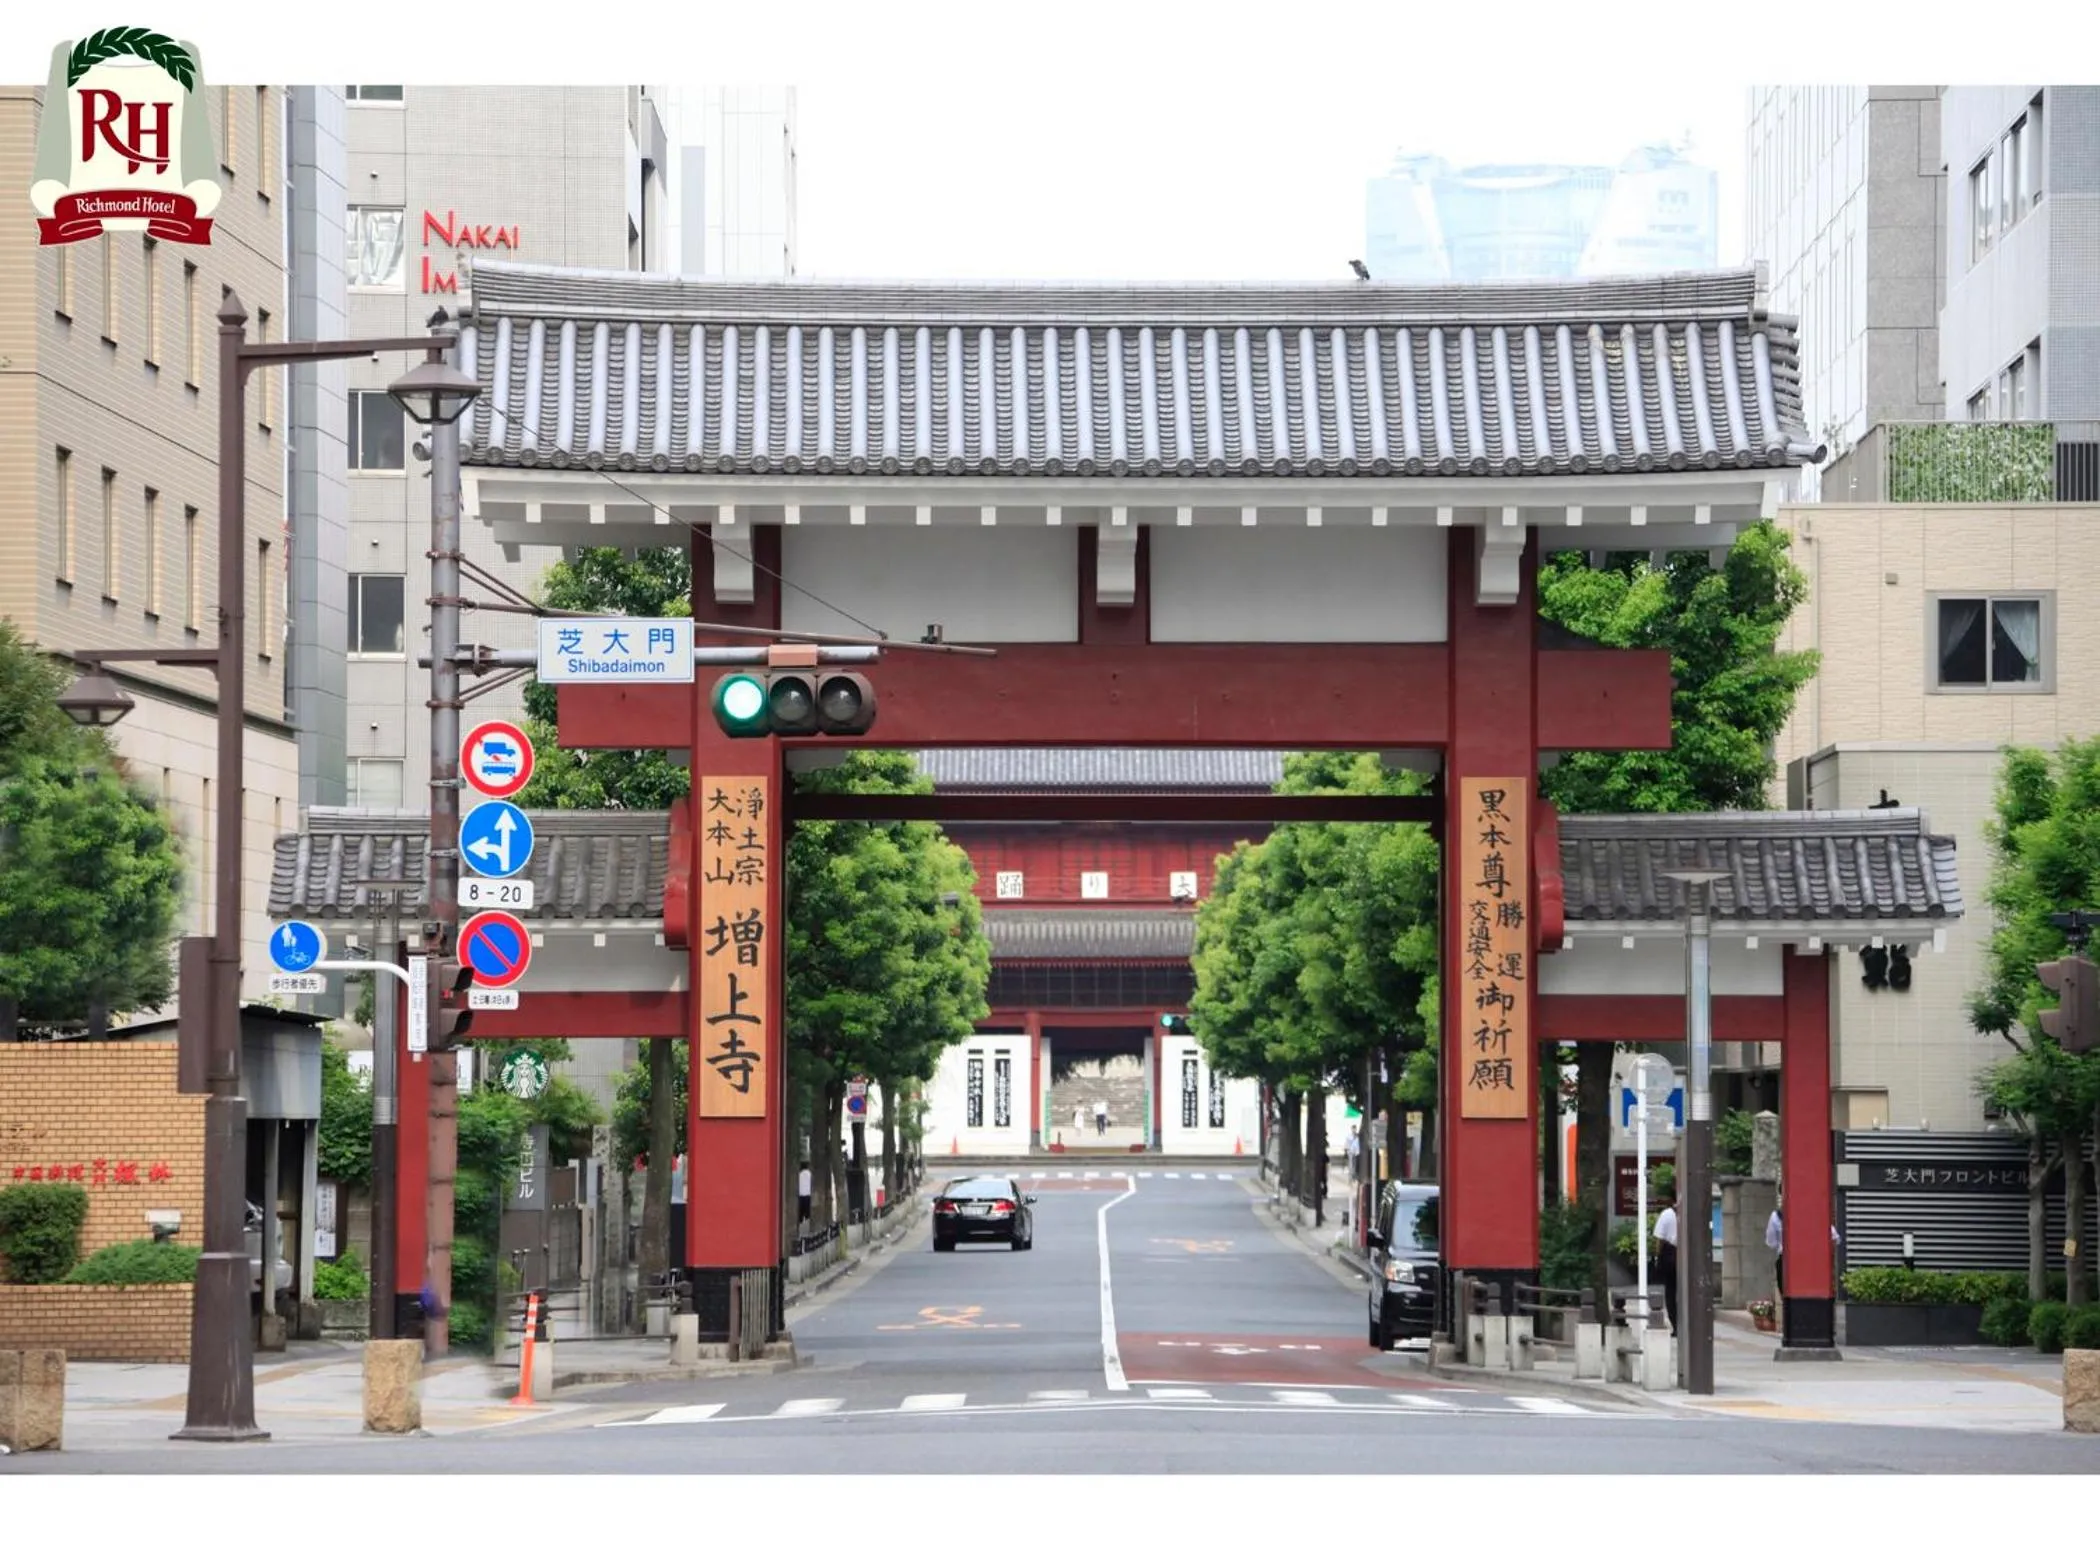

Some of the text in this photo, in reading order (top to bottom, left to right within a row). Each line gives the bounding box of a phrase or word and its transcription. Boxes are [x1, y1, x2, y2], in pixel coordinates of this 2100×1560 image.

[557, 628, 675, 655] 芝大門
[568, 659, 665, 673] Shibadaimon
[704, 787, 736, 886] 大本山
[1465, 899, 1494, 981] 交通安全
[1468, 980, 1515, 1091] 御祈願
